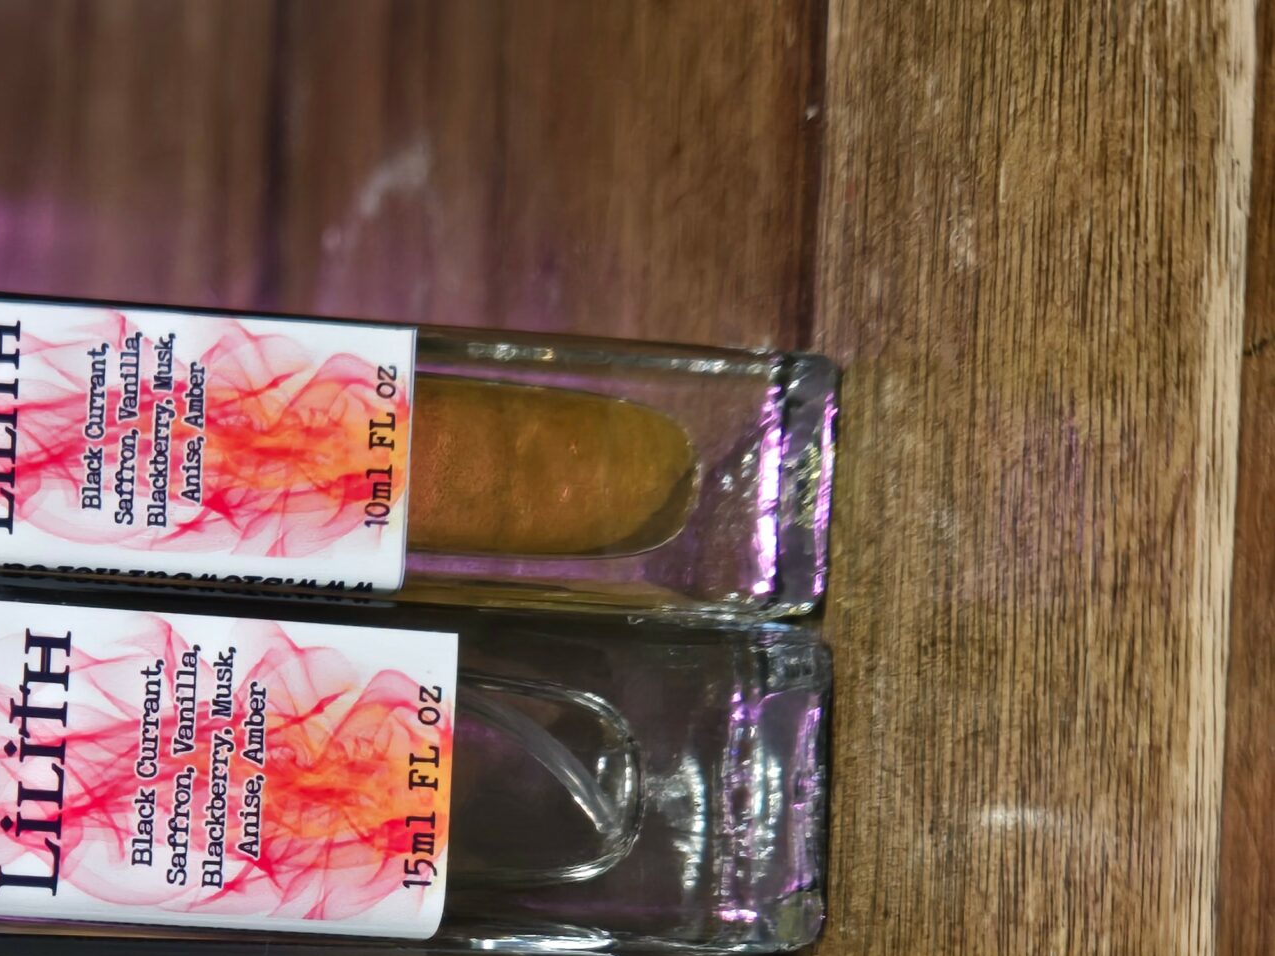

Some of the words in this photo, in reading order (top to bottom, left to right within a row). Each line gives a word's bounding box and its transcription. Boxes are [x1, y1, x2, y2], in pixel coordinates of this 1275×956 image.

[85, 342, 109, 440] Currant,
[119, 332, 141, 420] Vanilla,
[152, 333, 175, 390] Musk,
[185, 362, 205, 428] Amber
[376, 366, 397, 398] oz
[147, 399, 174, 528] Blackberry,
[180, 436, 204, 502] Anise,
[369, 412, 396, 449] FL
[82, 447, 104, 510] Black
[115, 429, 139, 525] Saffron,
[363, 464, 393, 528] 10ml
[136, 659, 165, 778] Currant,
[173, 644, 202, 754] Vanilla,
[211, 646, 236, 718] Musk,
[417, 685, 442, 726] oz
[243, 682, 266, 764] Amber
[409, 746, 440, 790] FL
[131, 790, 155, 866] Black
[165, 766, 196, 886] Saffron,
[202, 728, 234, 888] Blackberry,
[237, 774, 265, 858] Anise,
[402, 812, 439, 890] 15ml
